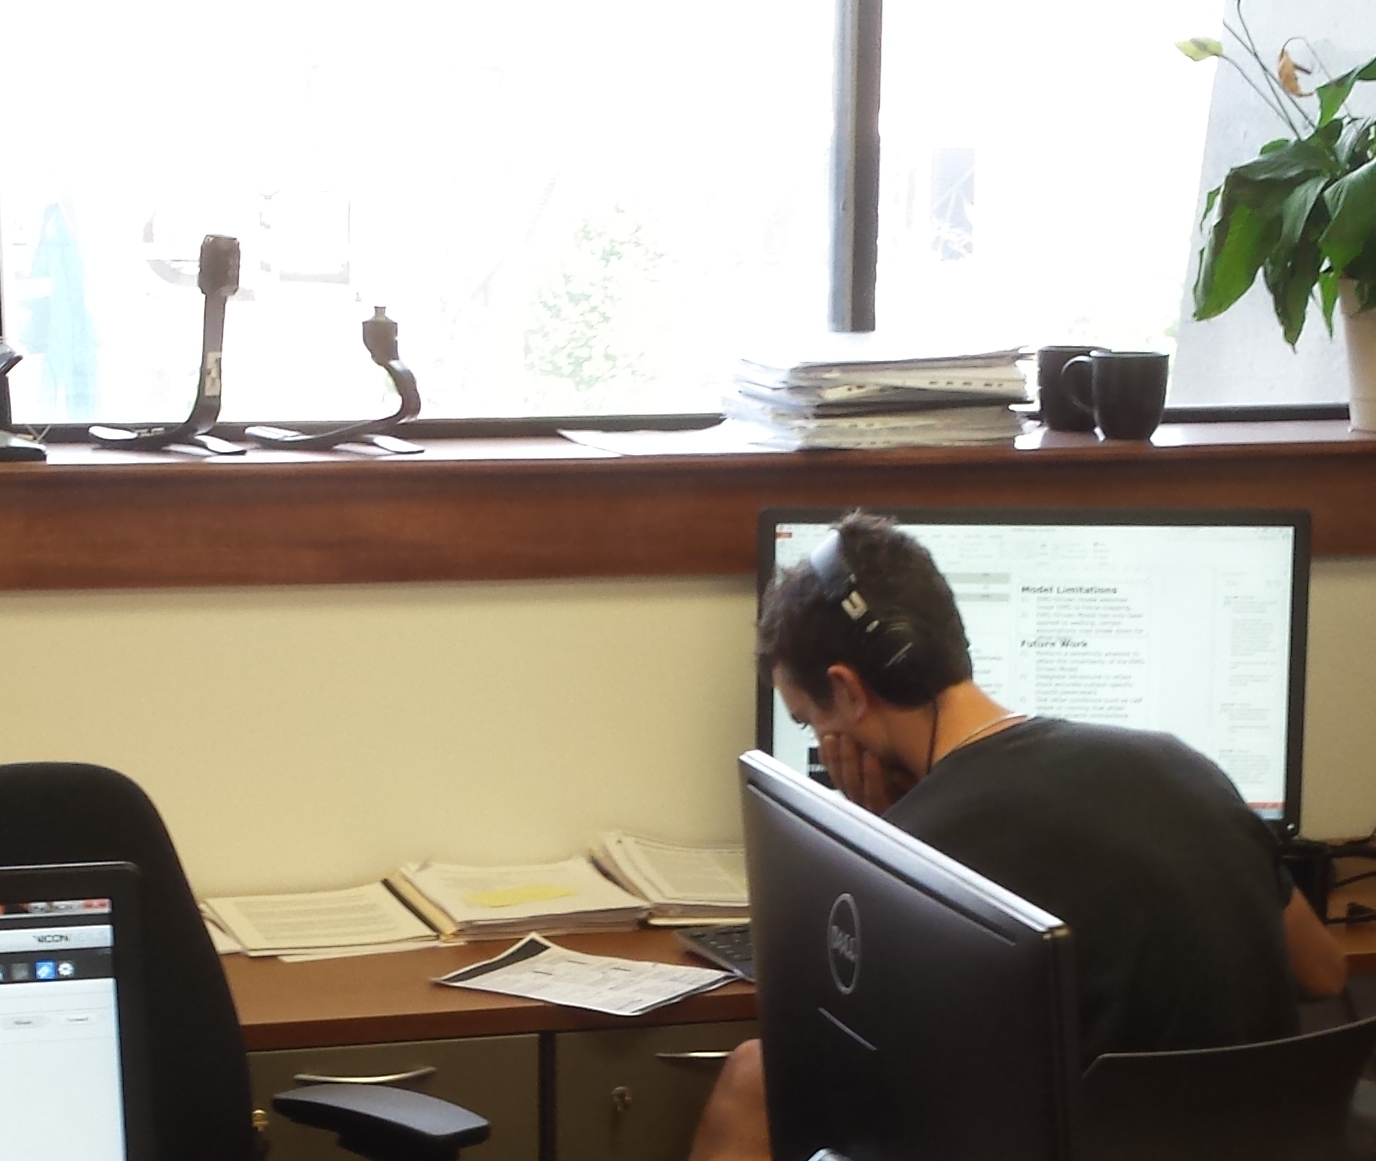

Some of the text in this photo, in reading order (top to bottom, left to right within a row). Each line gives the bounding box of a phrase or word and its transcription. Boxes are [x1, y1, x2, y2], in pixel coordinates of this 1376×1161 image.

[1021, 586, 1117, 594] Model Limitations
[1020, 640, 1056, 648] Future
